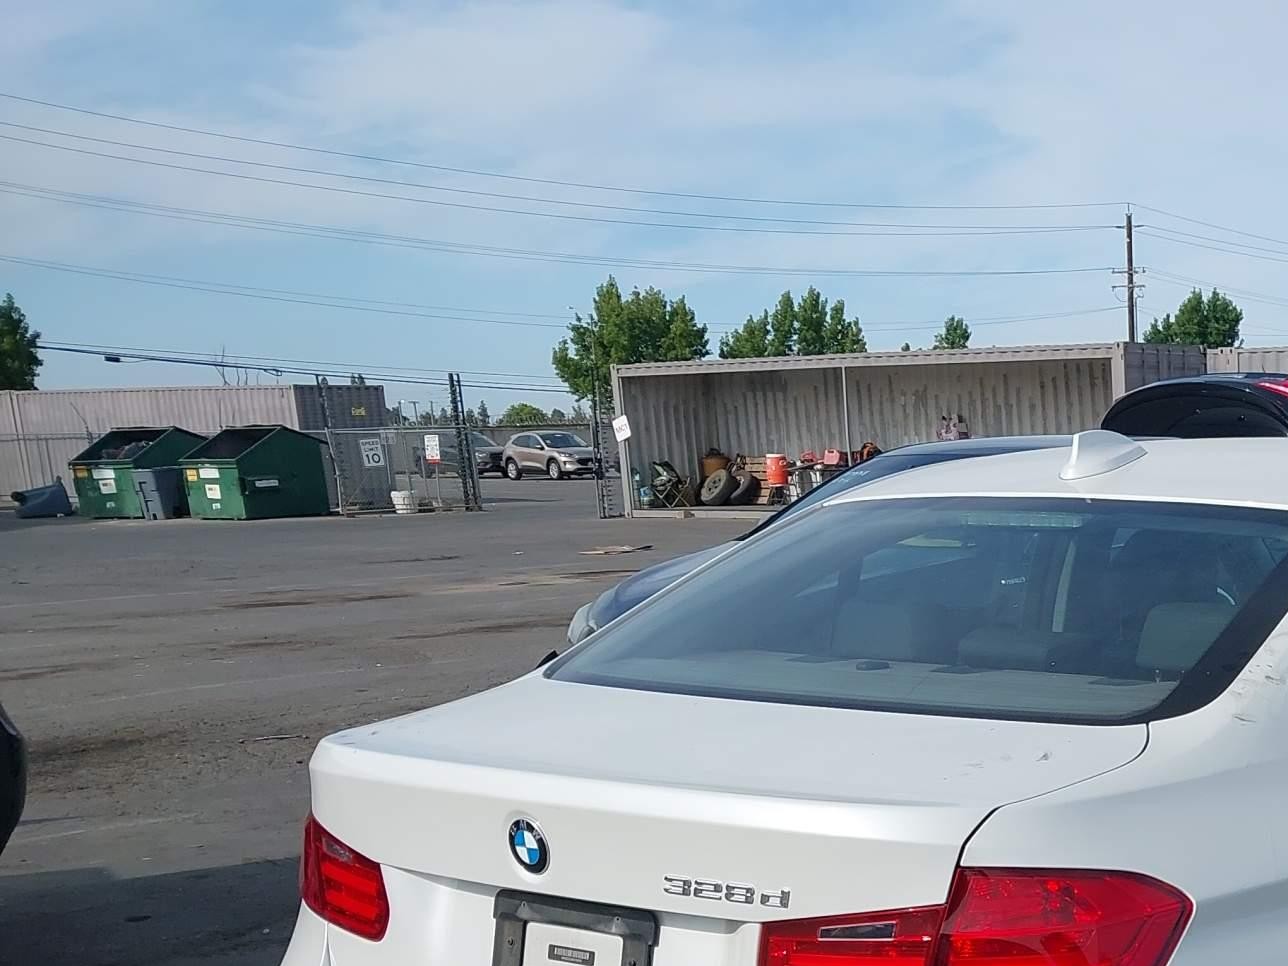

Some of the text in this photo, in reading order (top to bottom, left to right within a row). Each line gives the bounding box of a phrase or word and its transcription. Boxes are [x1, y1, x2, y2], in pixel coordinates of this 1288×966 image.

[366, 453, 381, 464] 10
[511, 819, 541, 840] BMW
[663, 874, 791, 908] 328d
